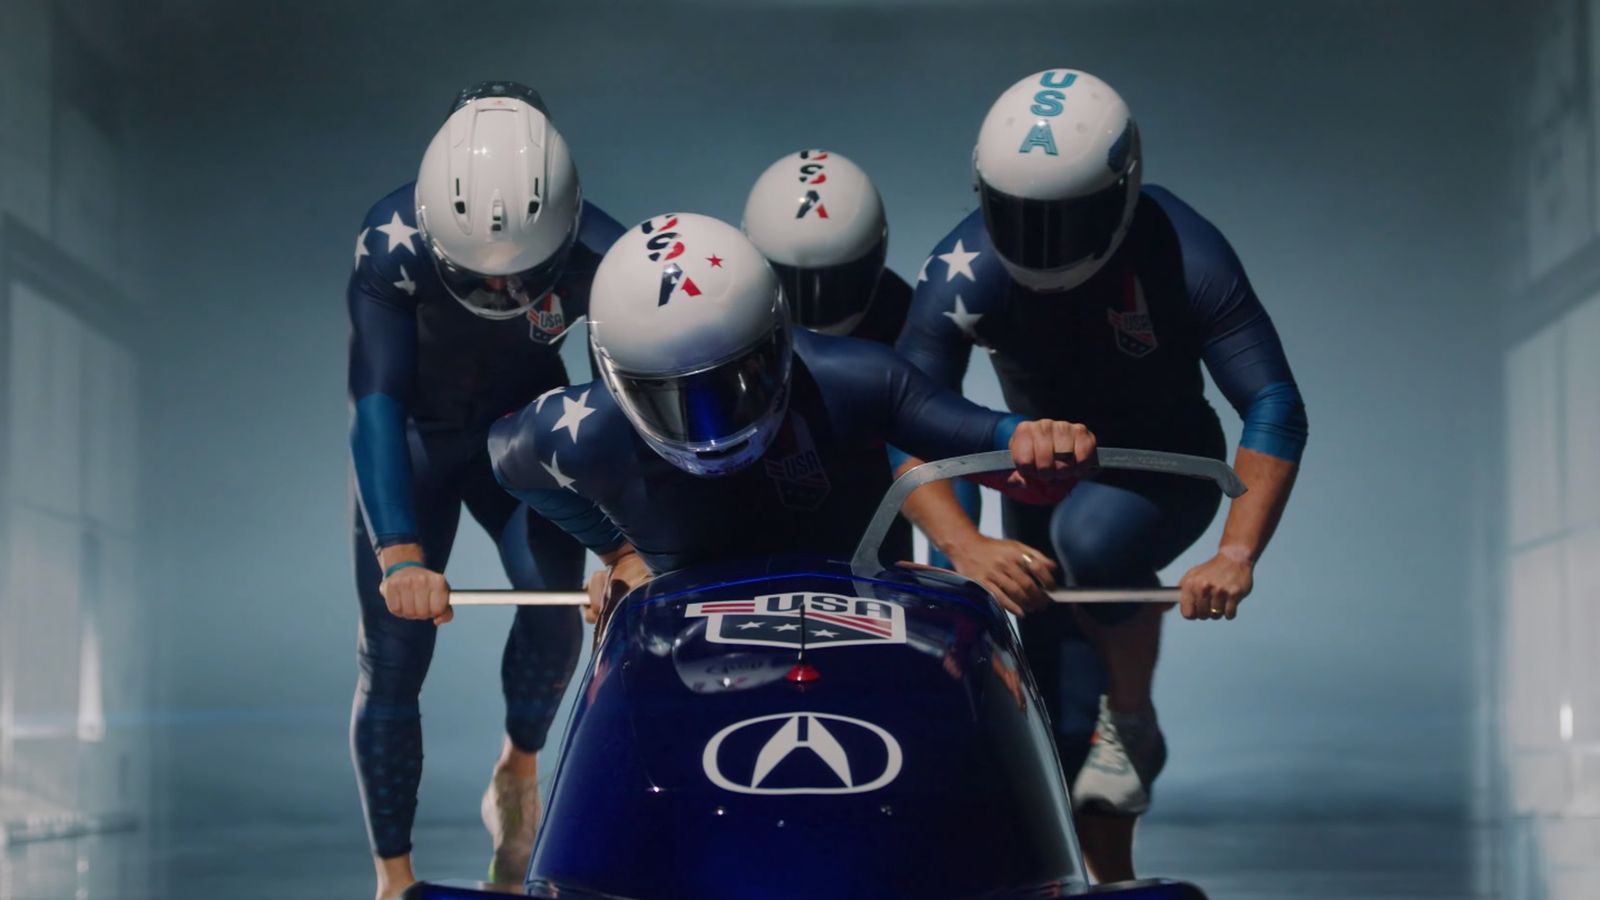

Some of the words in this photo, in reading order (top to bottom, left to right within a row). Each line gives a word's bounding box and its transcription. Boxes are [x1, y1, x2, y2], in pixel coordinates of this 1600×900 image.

[1019, 71, 1078, 156] USA
[539, 311, 563, 329] USA
[784, 450, 820, 479] USA
[767, 594, 892, 619] USA
